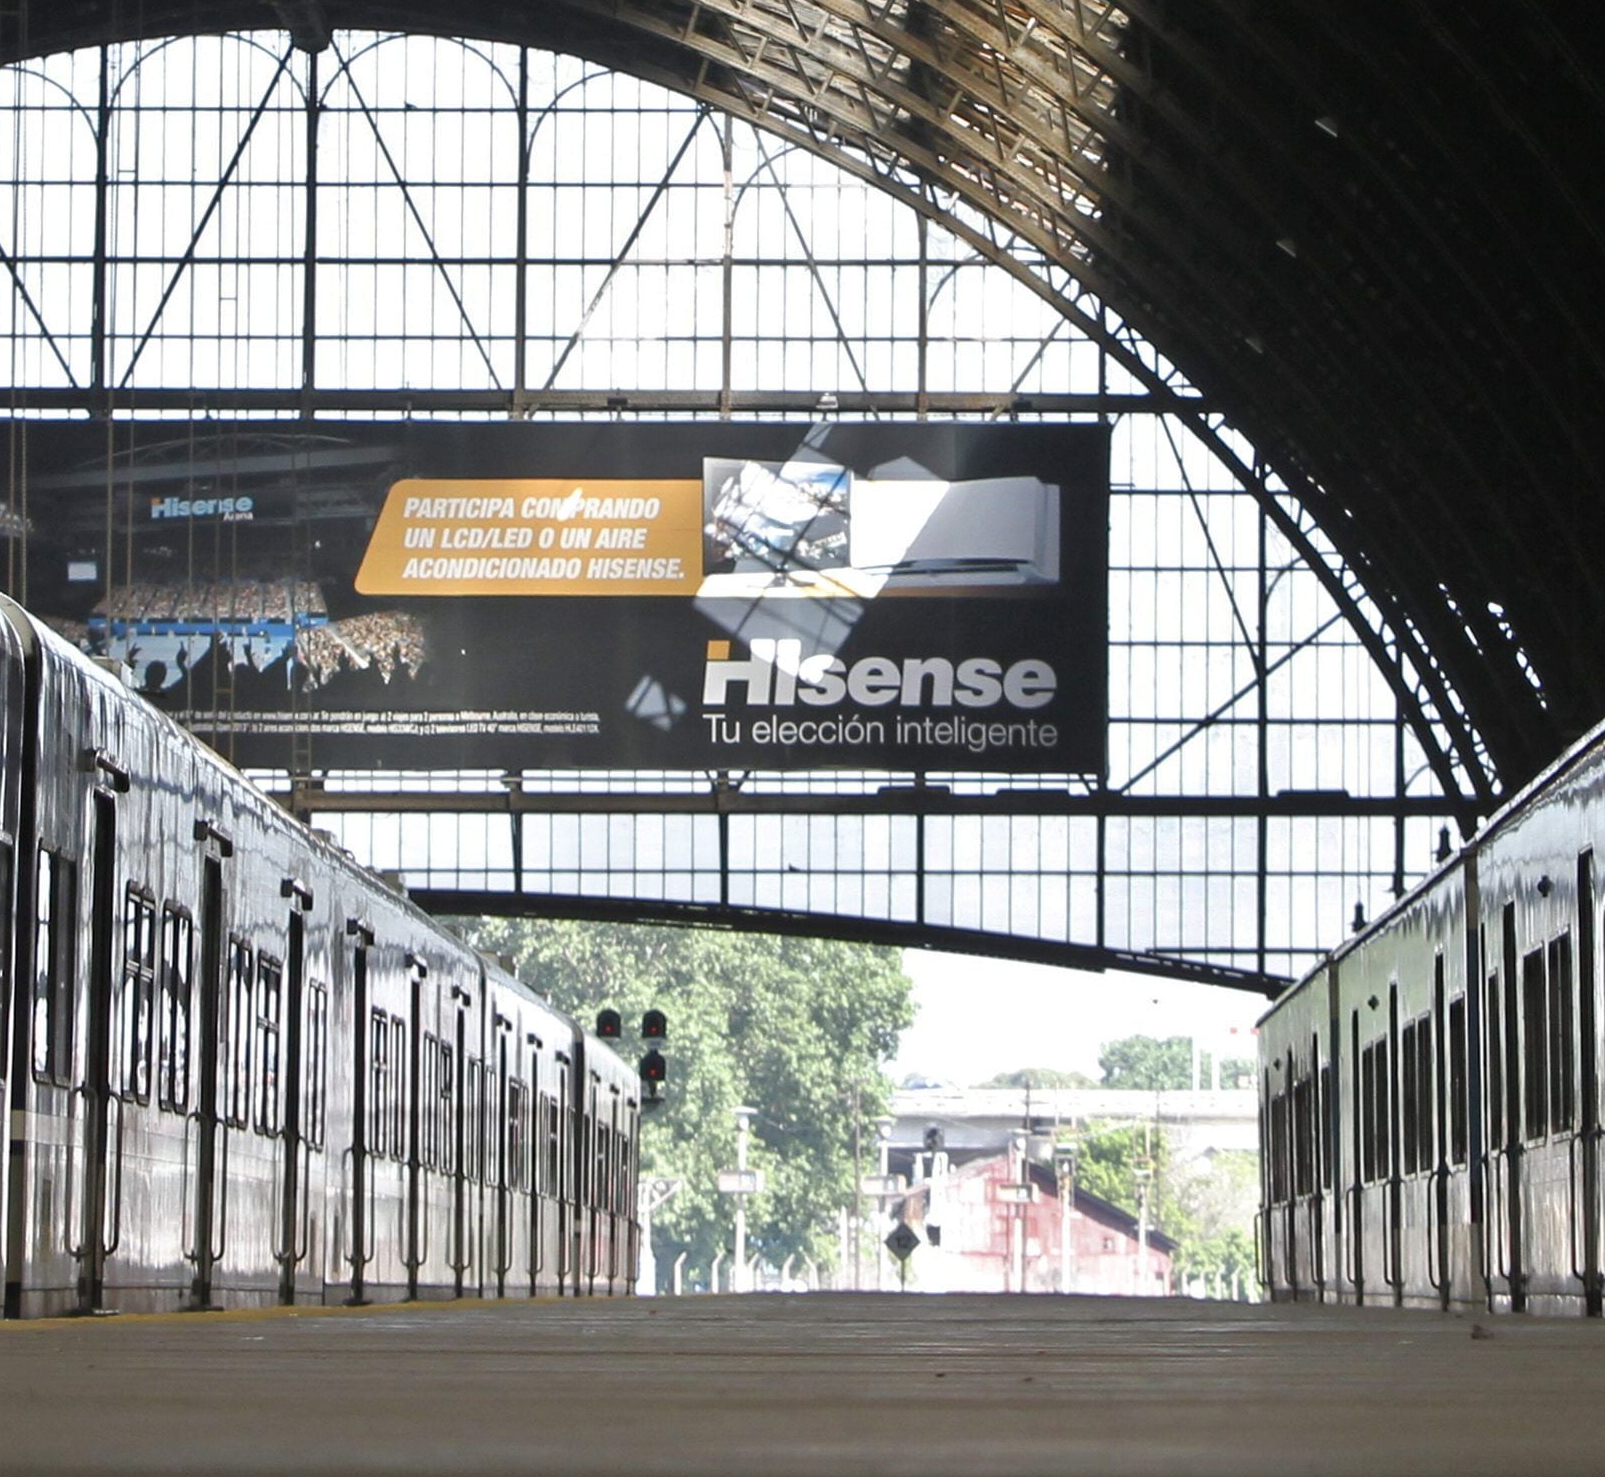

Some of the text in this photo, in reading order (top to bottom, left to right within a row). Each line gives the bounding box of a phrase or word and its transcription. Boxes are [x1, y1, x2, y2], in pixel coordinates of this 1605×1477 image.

[403, 497, 514, 519] PARTICIPA
[404, 527, 648, 549] UN LCD/LED O UN AIRE
[402, 557, 685, 580] ACONDICIONADO HISENSE.
[702, 639, 1057, 708] Hisense
[702, 714, 1058, 752] Tu elección inteligente
